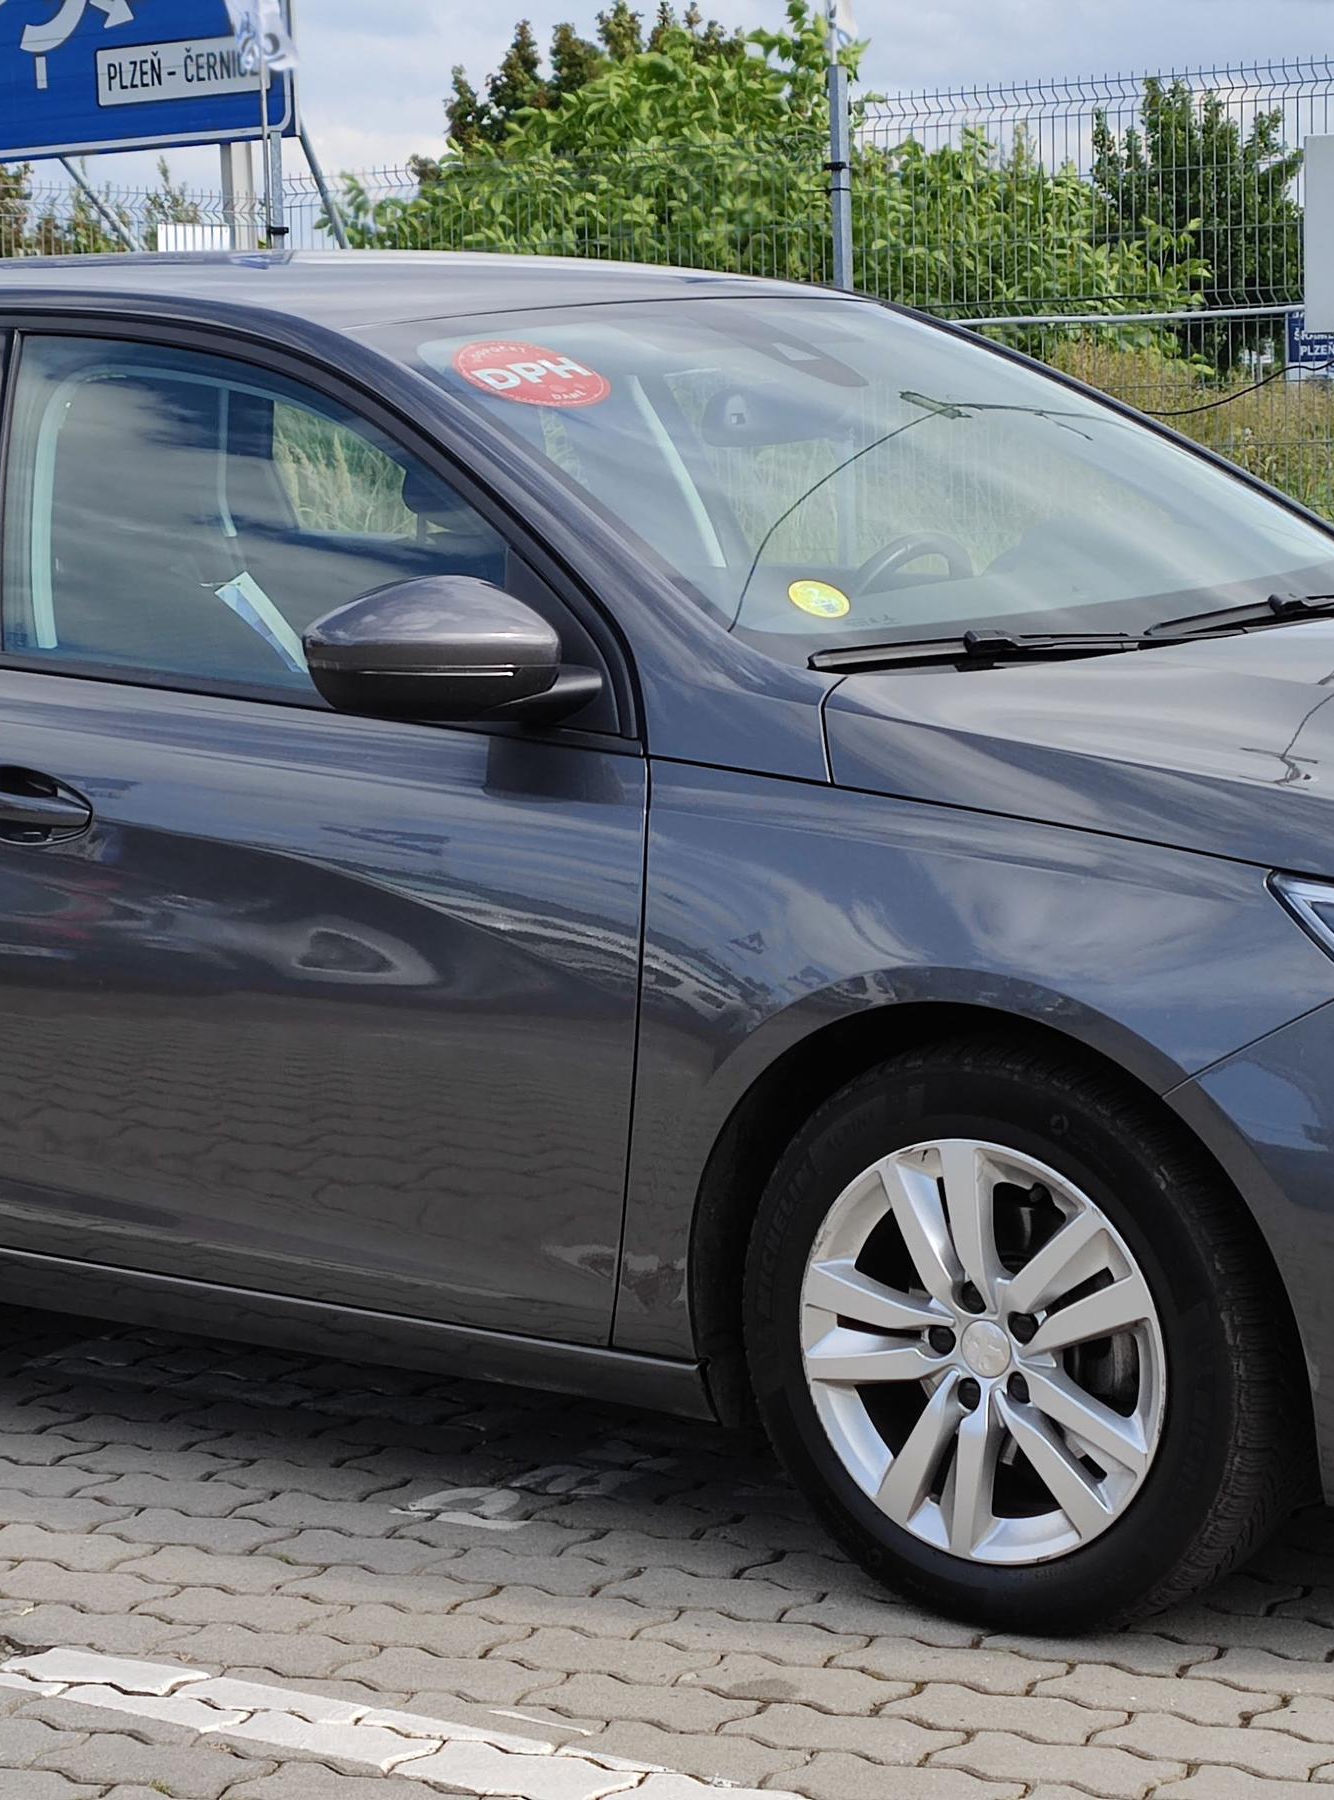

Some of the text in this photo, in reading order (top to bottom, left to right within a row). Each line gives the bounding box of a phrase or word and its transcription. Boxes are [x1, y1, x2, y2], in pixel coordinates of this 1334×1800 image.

[107, 51, 163, 91] PLZEŇ
[184, 47, 261, 83] ČERNIC
[471, 357, 593, 390] DPH
